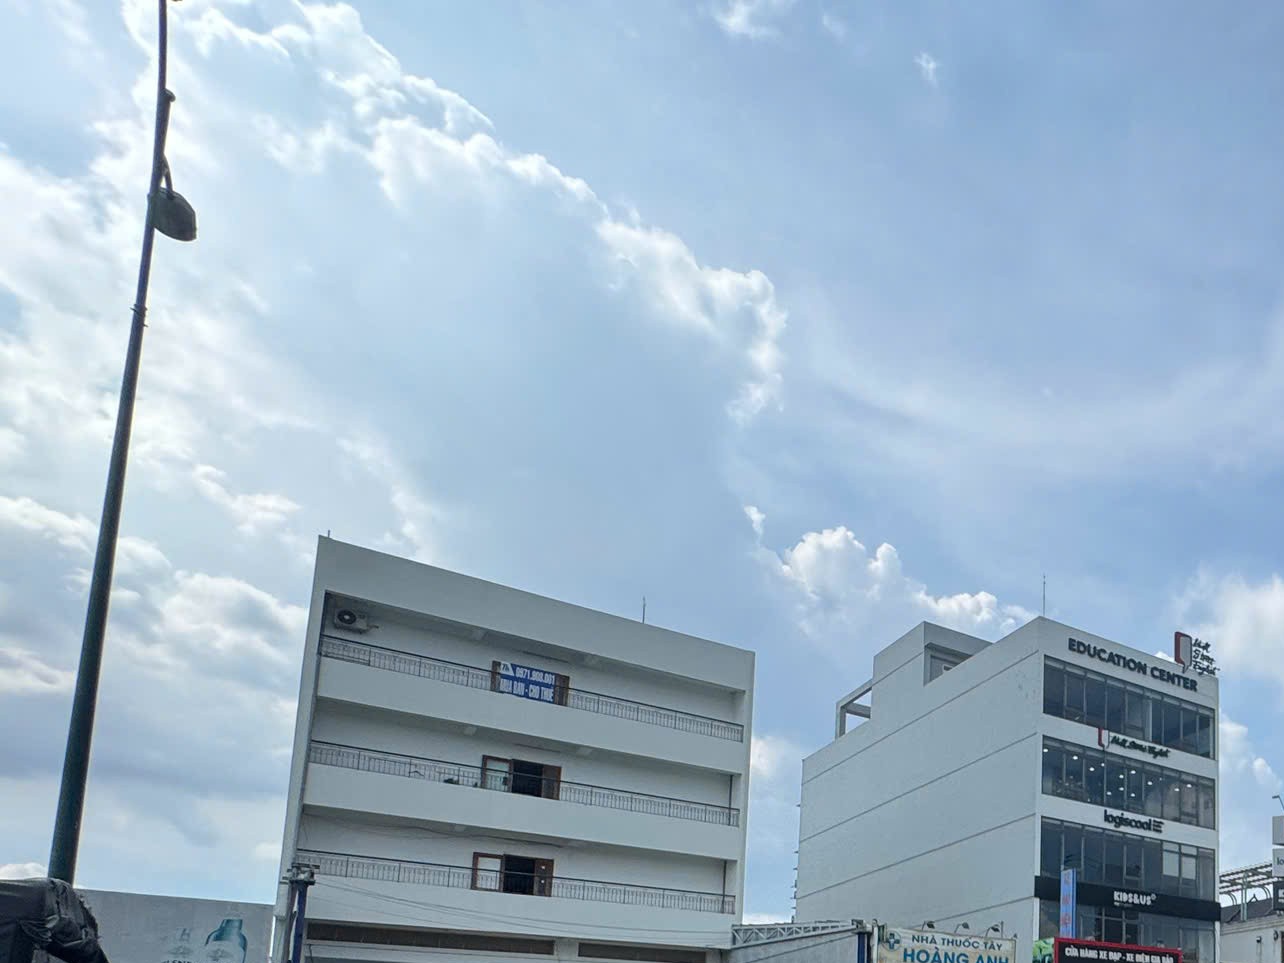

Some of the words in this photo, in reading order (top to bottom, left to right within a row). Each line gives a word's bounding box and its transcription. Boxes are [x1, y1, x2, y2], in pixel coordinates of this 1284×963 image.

[1068, 637, 1148, 675] EDUCATION
[1150, 666, 1198, 692] CENTER
[1104, 809, 1153, 832] logiscool
[1113, 891, 1152, 906] KIDS&US
[911, 934, 938, 945] NHÀ
[941, 936, 980, 949] THUỐC
[982, 942, 1003, 951] TÂY
[1080, 947, 1098, 959] HÀNG
[1099, 950, 1108, 959] XE
[1126, 953, 1134, 962] XE
[1151, 954, 1160, 963] GIA
